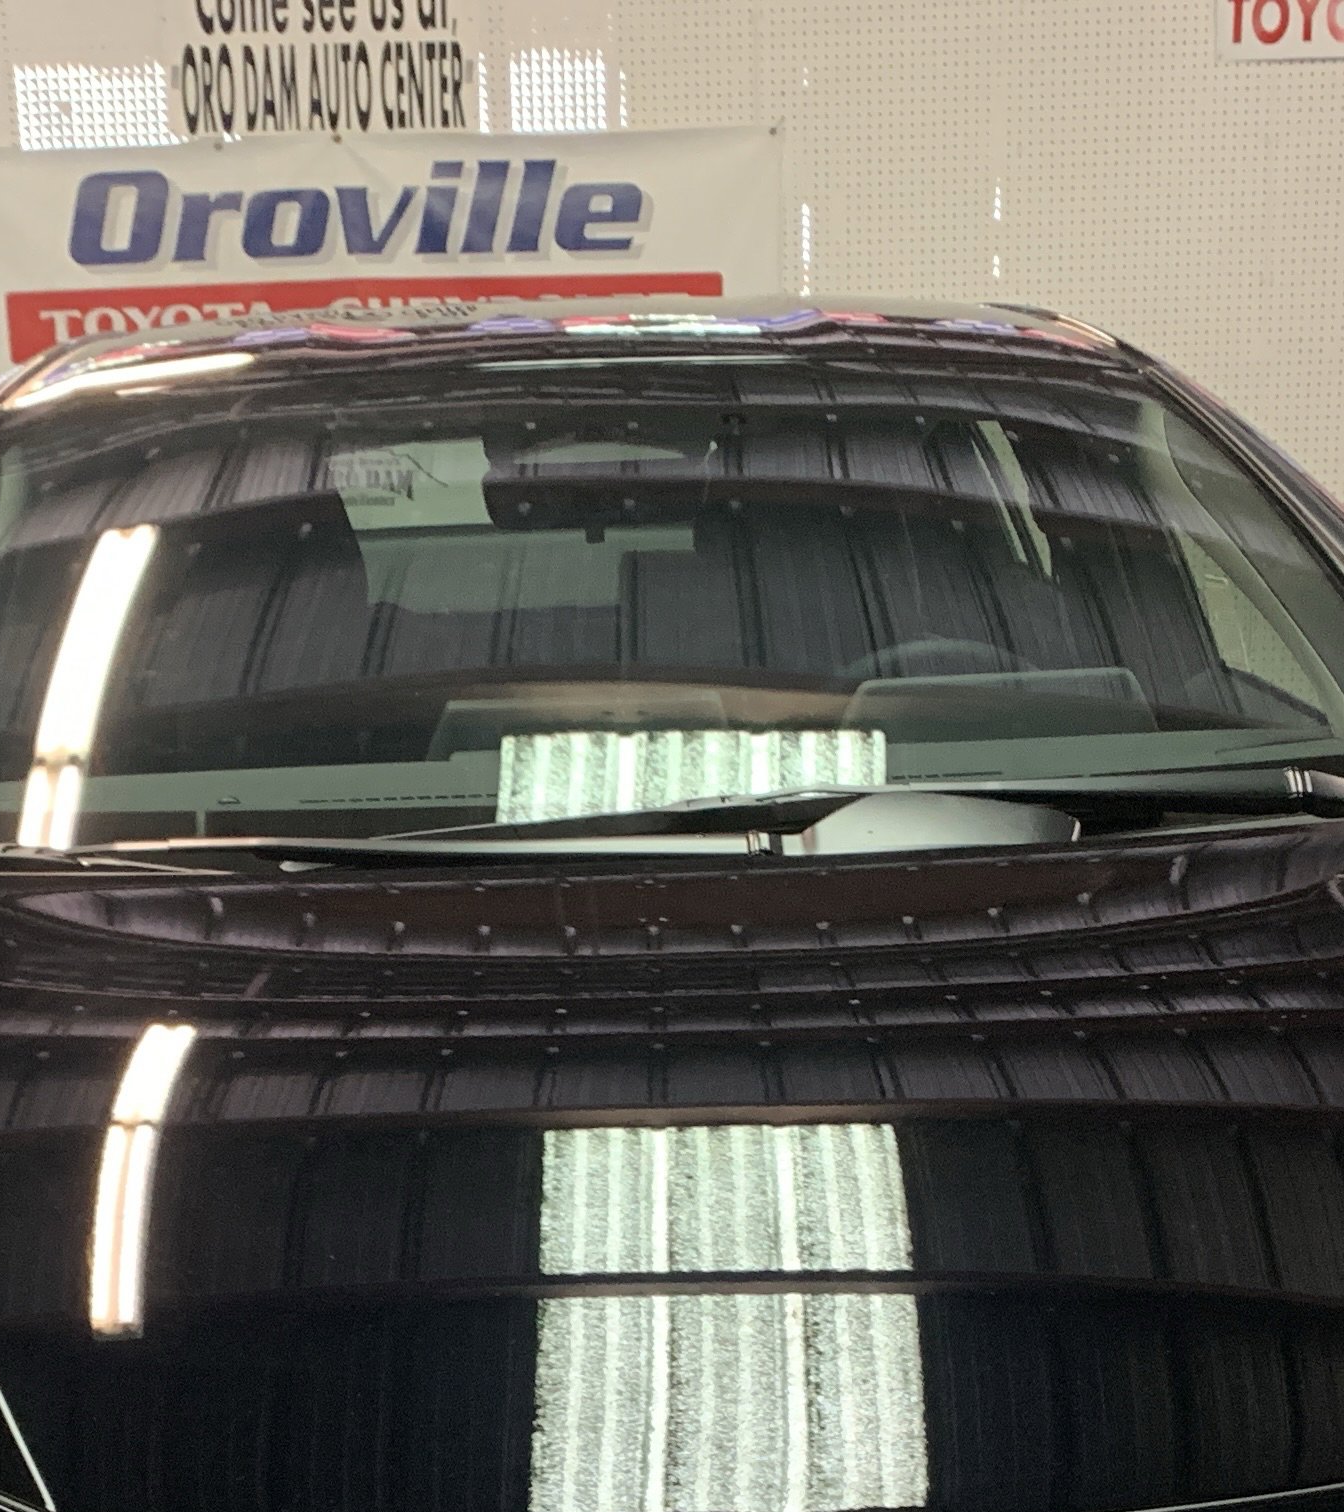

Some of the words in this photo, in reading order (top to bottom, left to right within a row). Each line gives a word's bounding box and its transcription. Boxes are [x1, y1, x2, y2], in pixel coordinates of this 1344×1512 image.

[302, 0, 355, 33] see
[368, 0, 405, 31] us
[182, 43, 235, 135] ORO
[240, 45, 301, 132] DAM
[308, 41, 372, 132] AUTO
[381, 40, 466, 131] CENTER
[68, 159, 646, 266] Oroville
